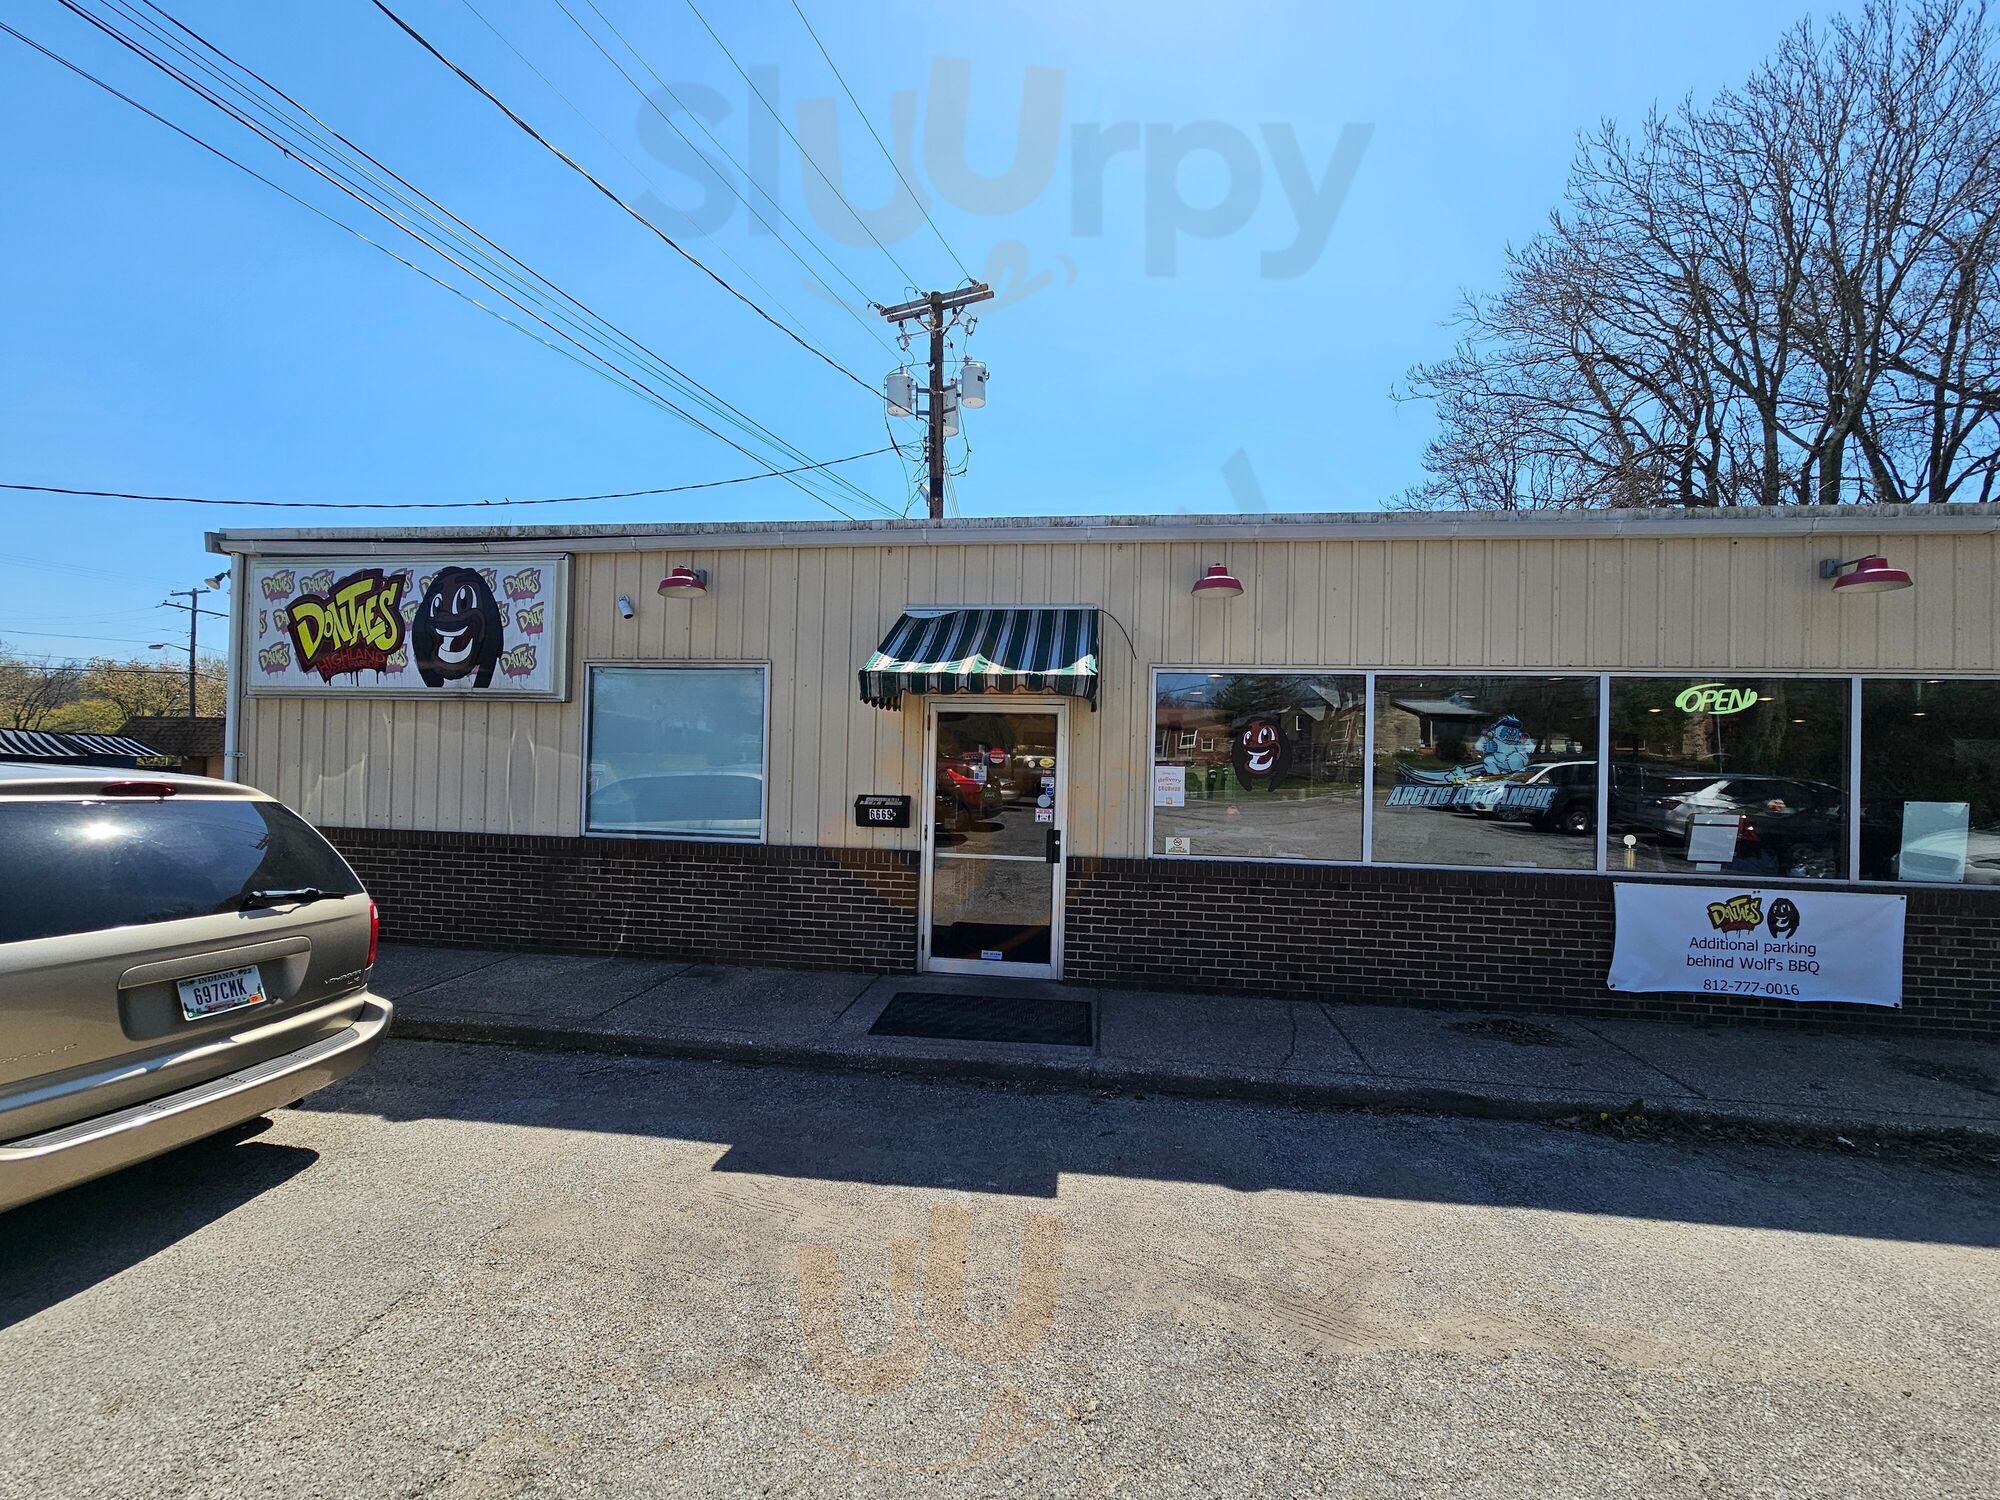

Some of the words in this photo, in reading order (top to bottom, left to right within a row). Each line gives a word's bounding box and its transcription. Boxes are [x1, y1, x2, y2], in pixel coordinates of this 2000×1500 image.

[317, 647, 385, 672] HIGHLAND
[1681, 687, 1751, 713] OPEN
[1385, 785, 1452, 807] ARCTIC
[1452, 786, 1557, 809] AVALANCHE
[870, 808, 892, 820] 6669
[1689, 937, 1758, 952] Additional
[1764, 941, 1817, 957] parking
[1686, 954, 1734, 968] behind
[1739, 957, 1784, 972] Wolf's
[1788, 960, 1820, 975] BBQ
[198, 971, 235, 984] INDIANA
[1703, 979, 1800, 996] 812-777-0016
[193, 977, 247, 1006] 697CMK
